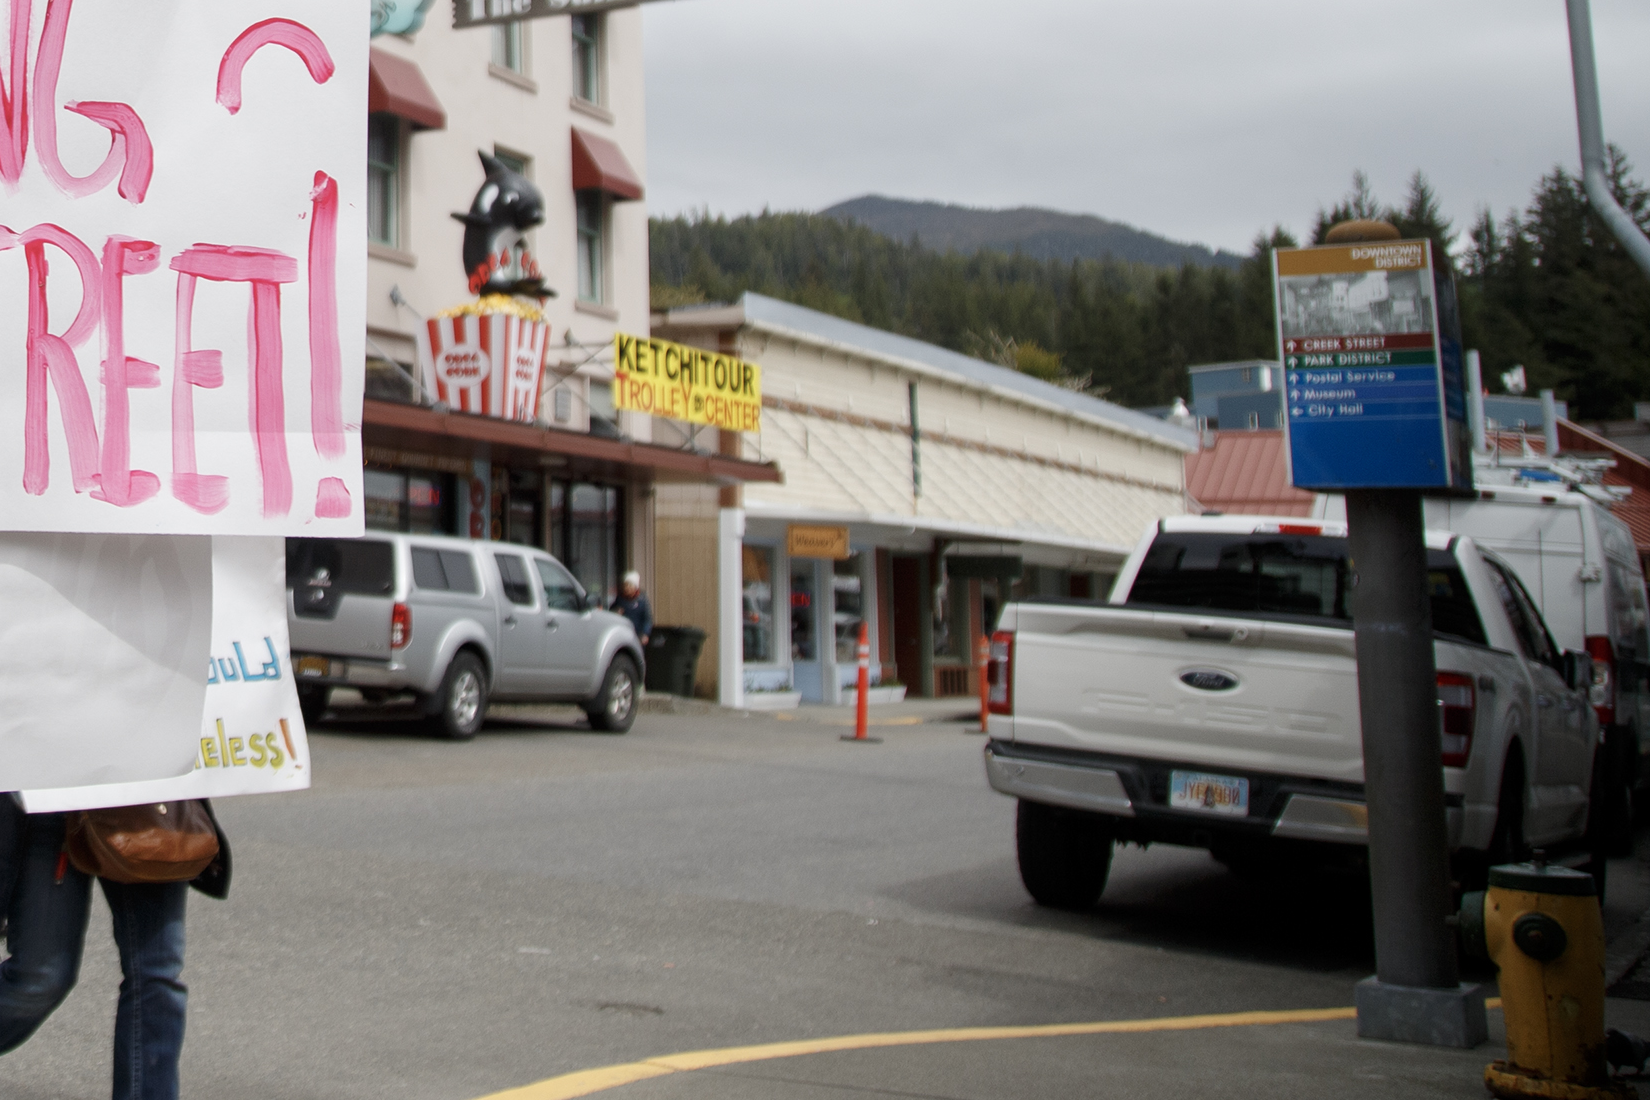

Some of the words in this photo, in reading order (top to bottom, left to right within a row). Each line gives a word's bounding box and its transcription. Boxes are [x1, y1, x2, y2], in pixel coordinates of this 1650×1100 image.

[1352, 244, 1422, 260] DOWNTOWN
[1375, 256, 1422, 269] DISTRICT
[1303, 339, 1341, 351] CREEK
[1346, 337, 1386, 349] STREET
[618, 334, 755, 397] KETCHITOUR
[1304, 355, 1334, 367] PARK
[1339, 352, 1392, 365] DISTRICT
[1306, 372, 1342, 384] Postal
[1347, 370, 1396, 383] Service
[616, 371, 693, 419] TROLLEY
[705, 394, 761, 431] CENTER
[1304, 388, 1356, 400] Museum
[1309, 404, 1334, 418] City
[1339, 403, 1364, 415] Hall
[195, 717, 303, 770] eless!
